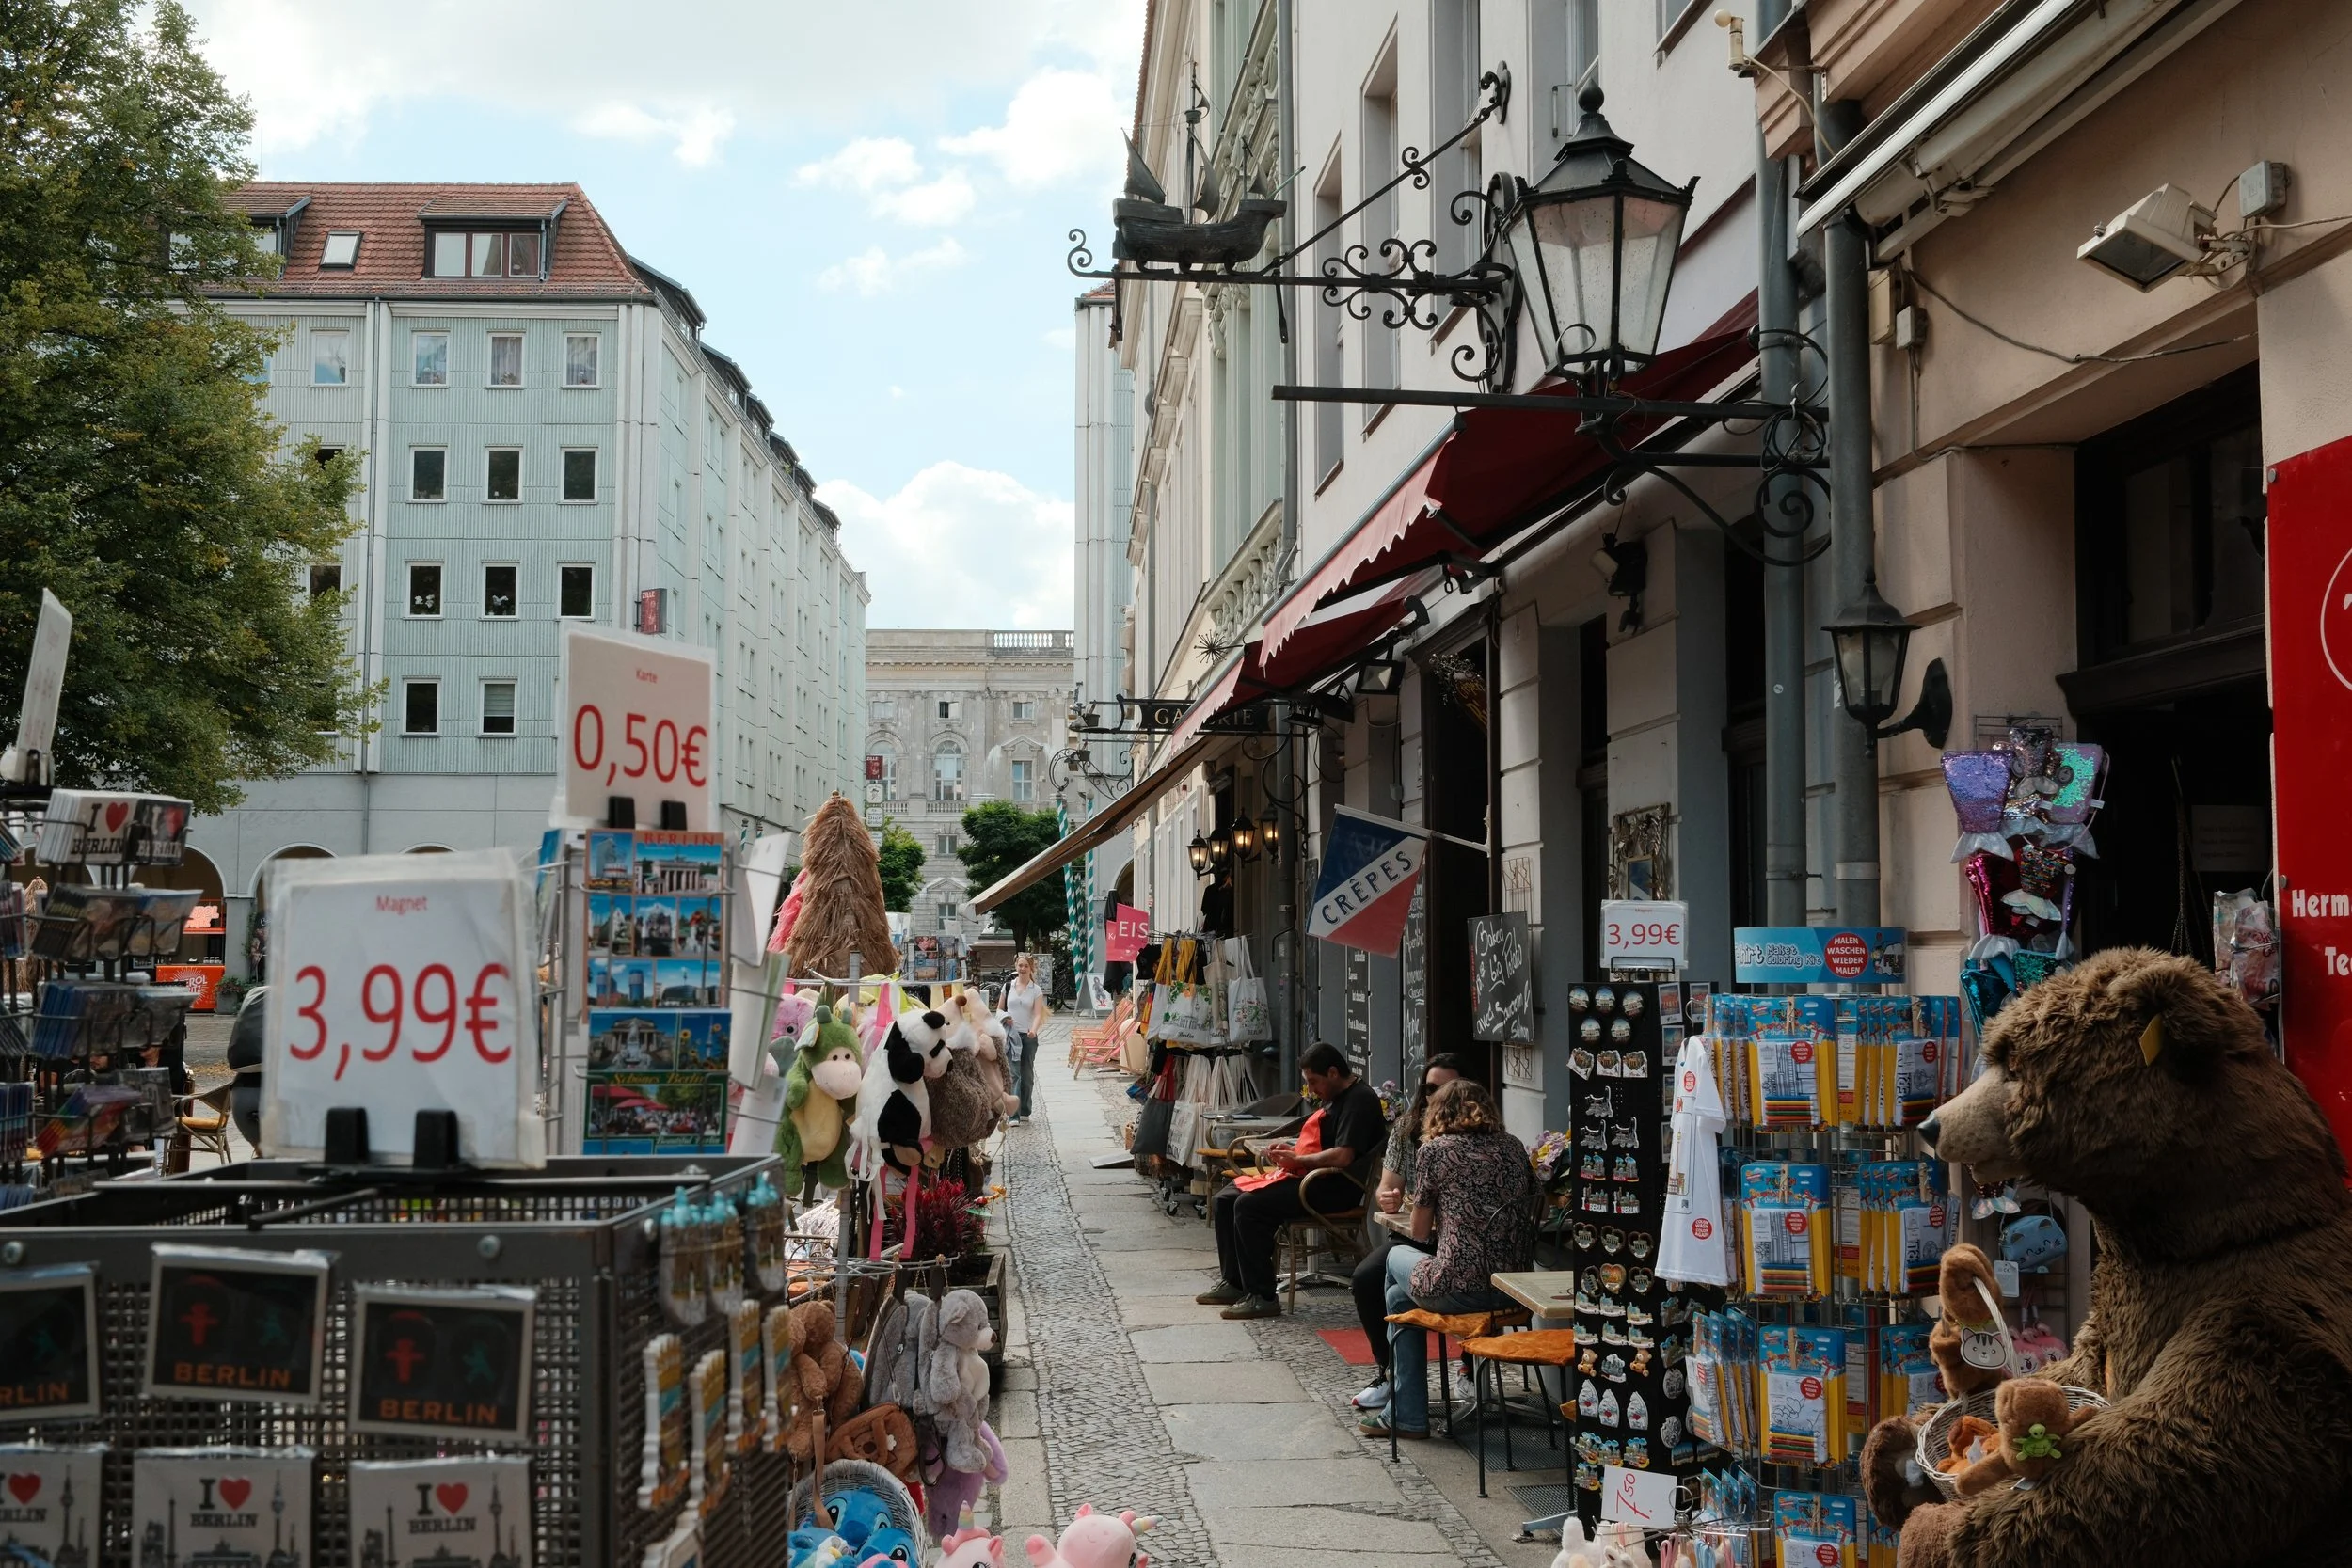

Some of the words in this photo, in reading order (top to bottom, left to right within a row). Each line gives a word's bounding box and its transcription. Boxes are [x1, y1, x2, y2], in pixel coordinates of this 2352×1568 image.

[636, 668, 659, 683] Karte
[1154, 707, 1255, 727] GARIE
[574, 704, 707, 787] 0,50€
[1321, 850, 1413, 925] CRÊPES
[375, 895, 428, 915] Magnet
[2291, 889, 2352, 917] Herm
[1119, 921, 1149, 939] EIS
[1607, 923, 1680, 950] 3,99€
[1804, 953, 1823, 965] Kit
[1827, 946, 1866, 955] WASCHEN
[1832, 957, 1864, 965] WIEDER
[1836, 966, 1861, 974] MALEN
[2324, 946, 2352, 976] Te
[290, 962, 512, 1082] 3,99€
[173, 1360, 292, 1389] BERLIN
[0, 1382, 69, 1405] RLIN
[380, 1399, 498, 1424] BERLIN
[190, 1513, 259, 1528] BERLIN
[408, 1517, 477, 1534] BERLIN
